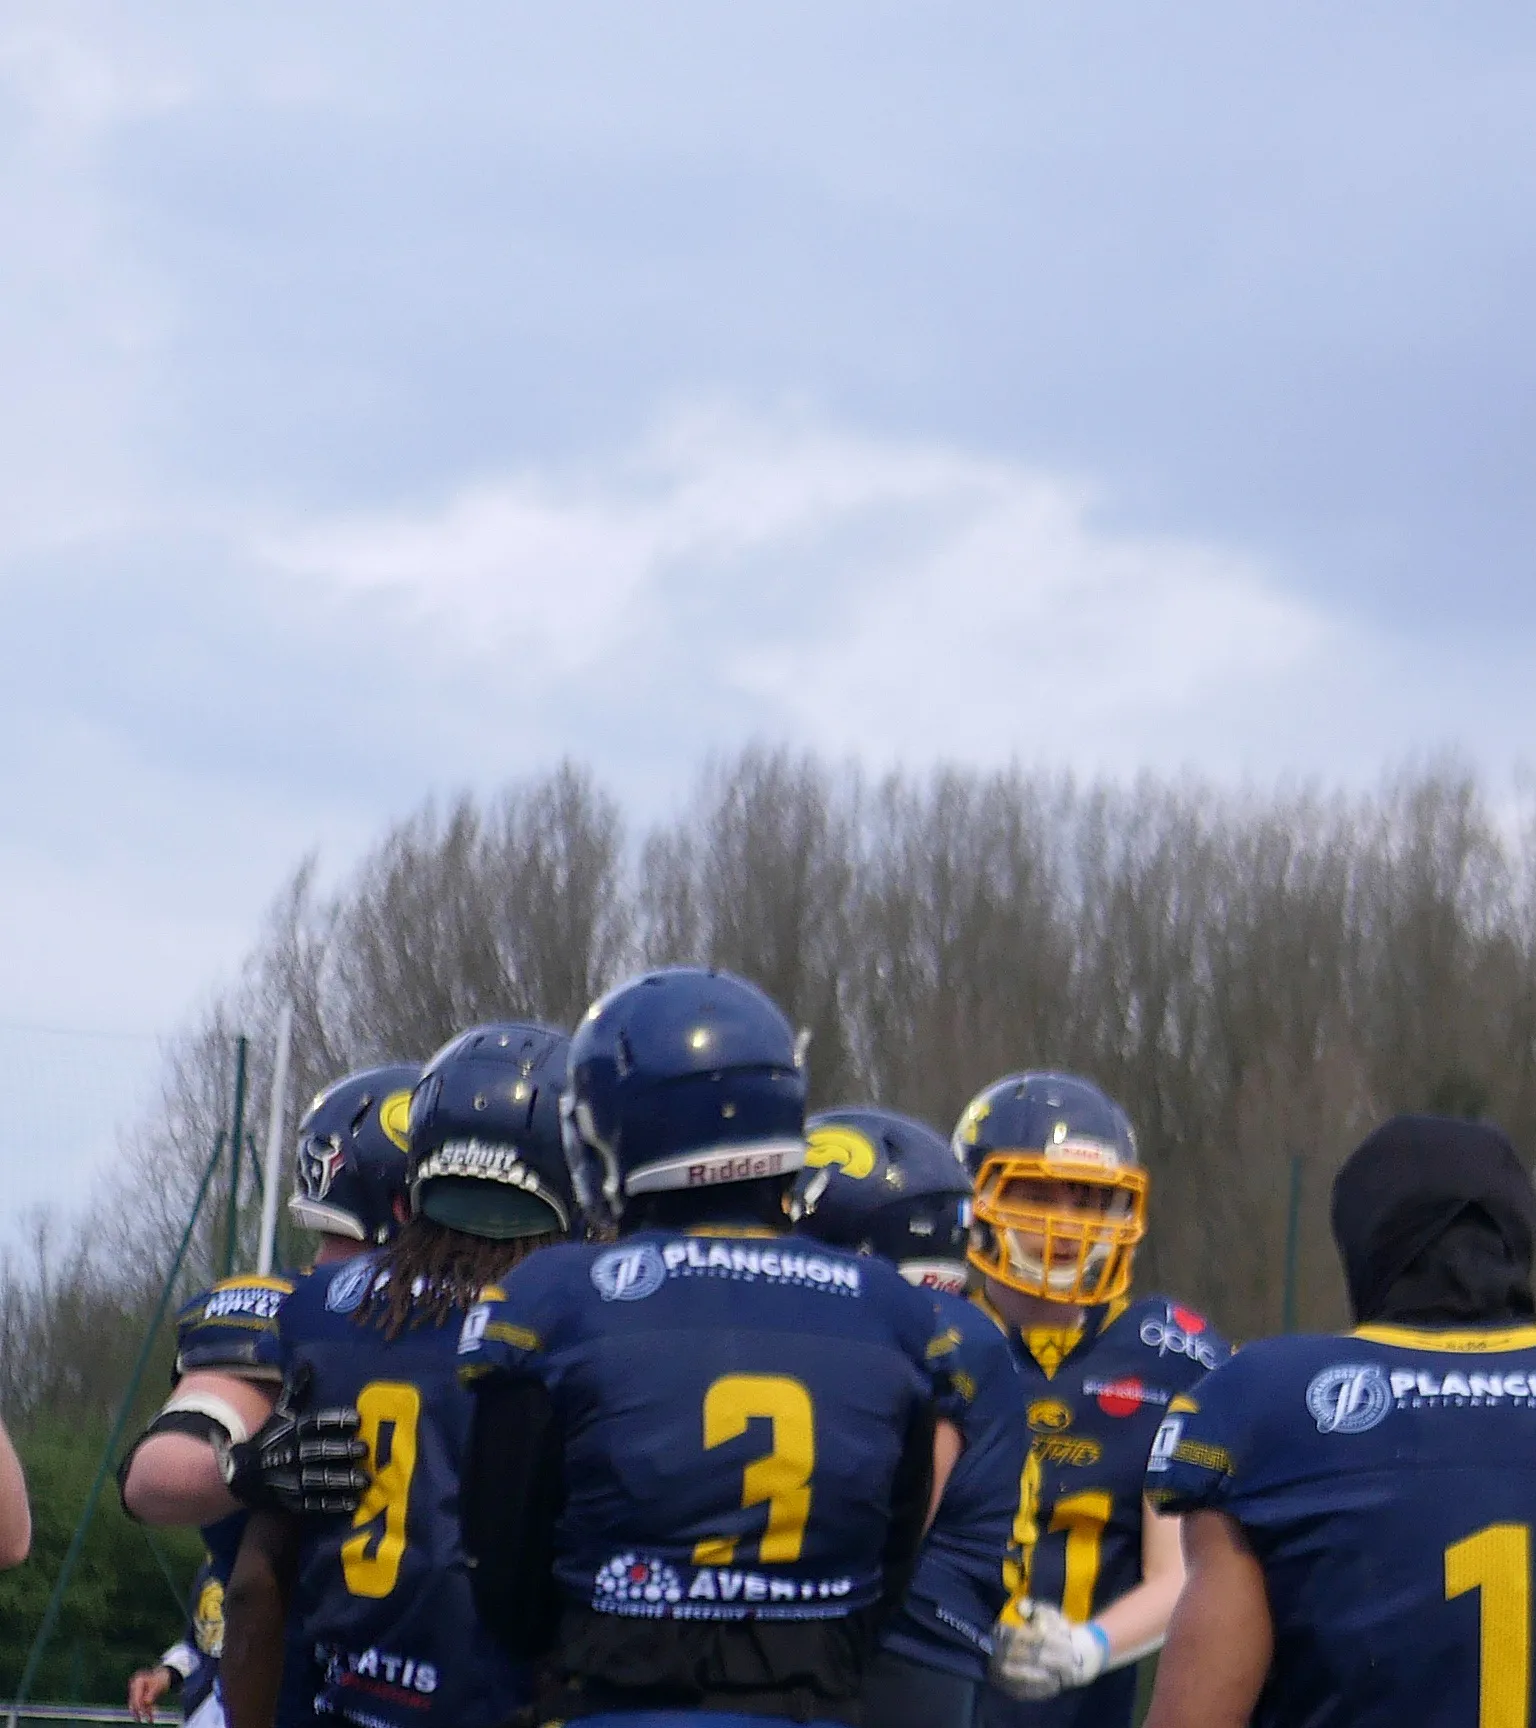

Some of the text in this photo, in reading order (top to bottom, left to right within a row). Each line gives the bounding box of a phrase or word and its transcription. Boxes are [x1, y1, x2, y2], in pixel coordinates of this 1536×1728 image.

[688, 1152, 784, 1185] Riddell
[662, 1242, 859, 1291] PLANCHON
[691, 1372, 816, 1566] 3
